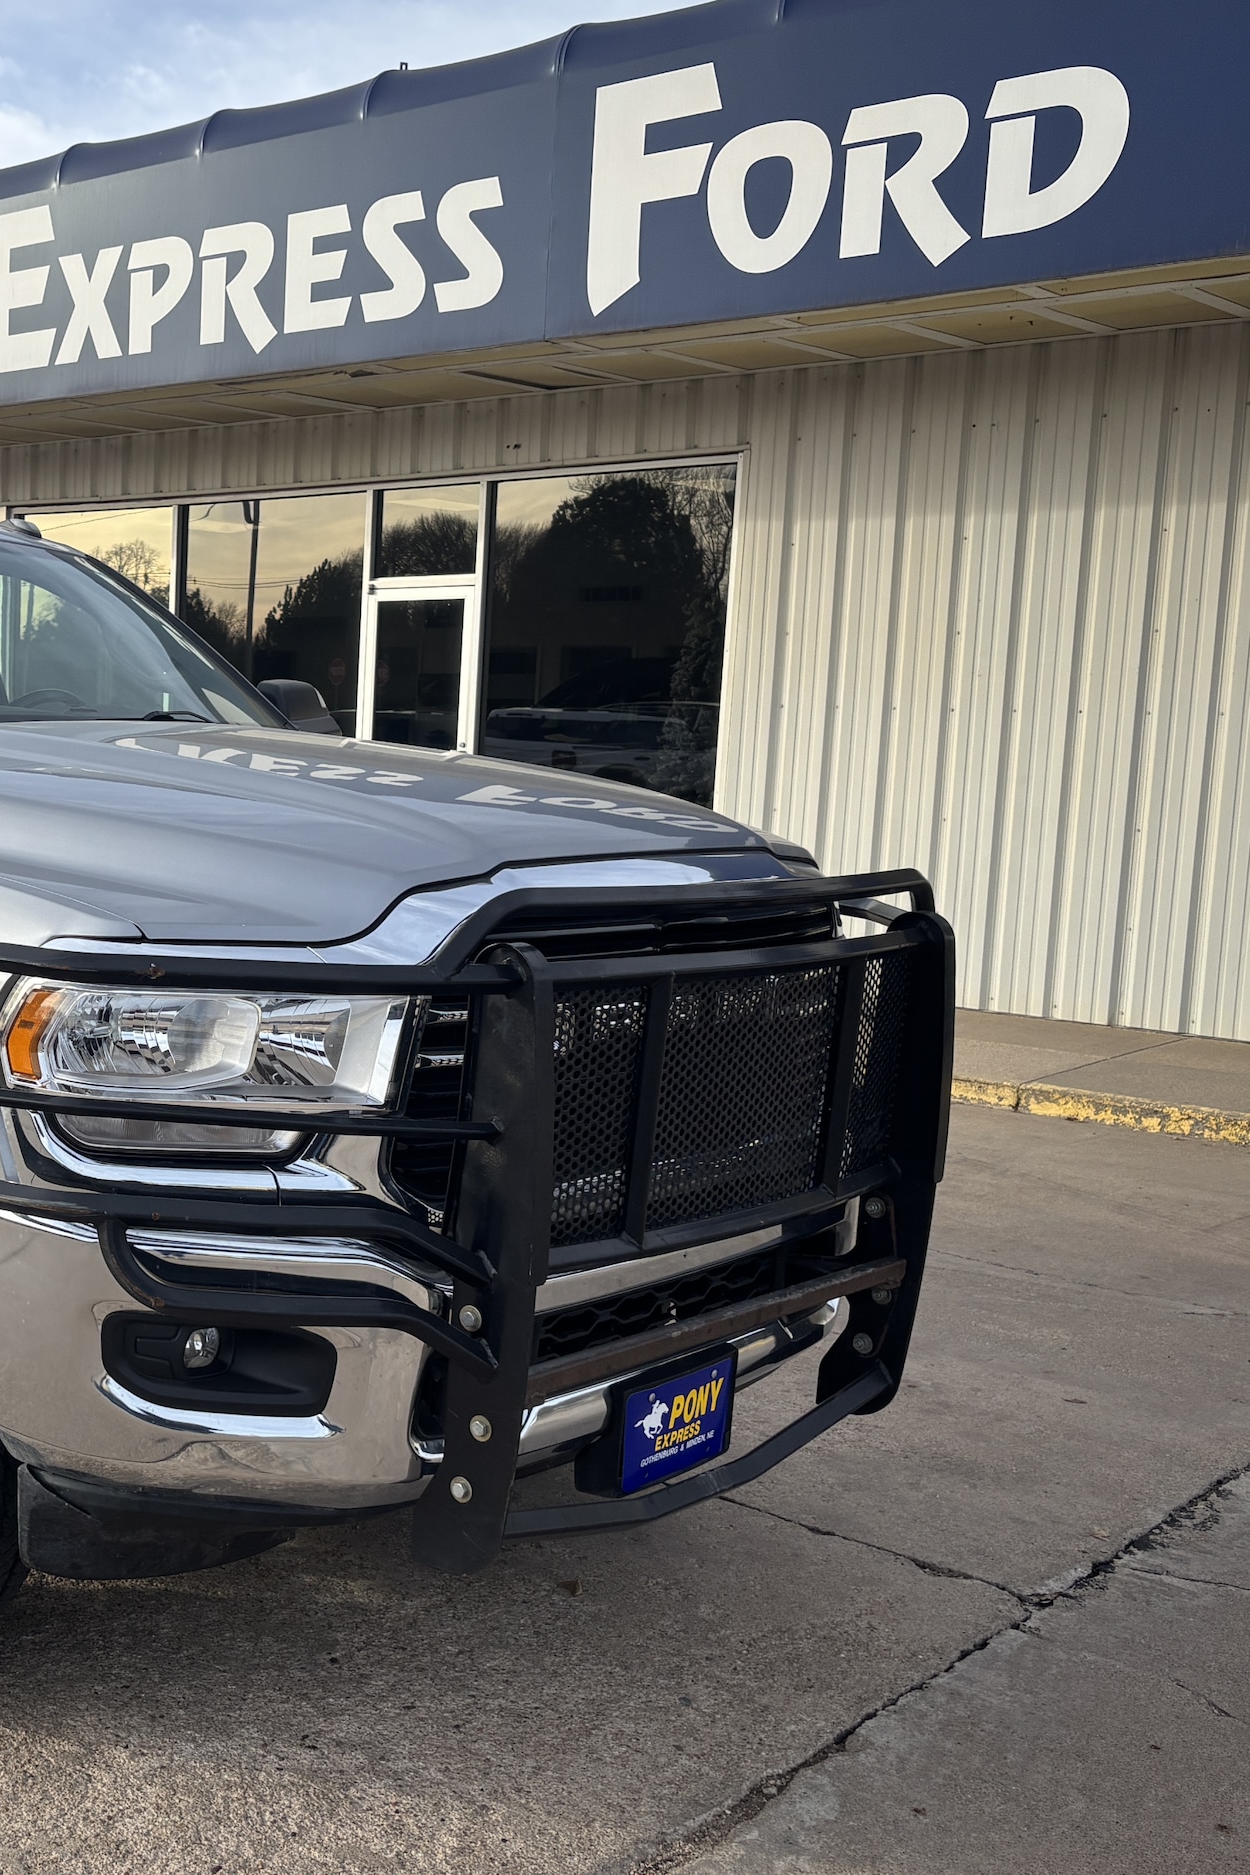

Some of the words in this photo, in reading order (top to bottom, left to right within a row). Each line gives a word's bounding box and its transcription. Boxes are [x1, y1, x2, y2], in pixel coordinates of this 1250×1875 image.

[586, 62, 1130, 317] FORD
[669, 1378, 724, 1429] PONY
[640, 1445, 679, 1468] GOTHENBURG
[654, 1420, 701, 1452] EXPRESS
